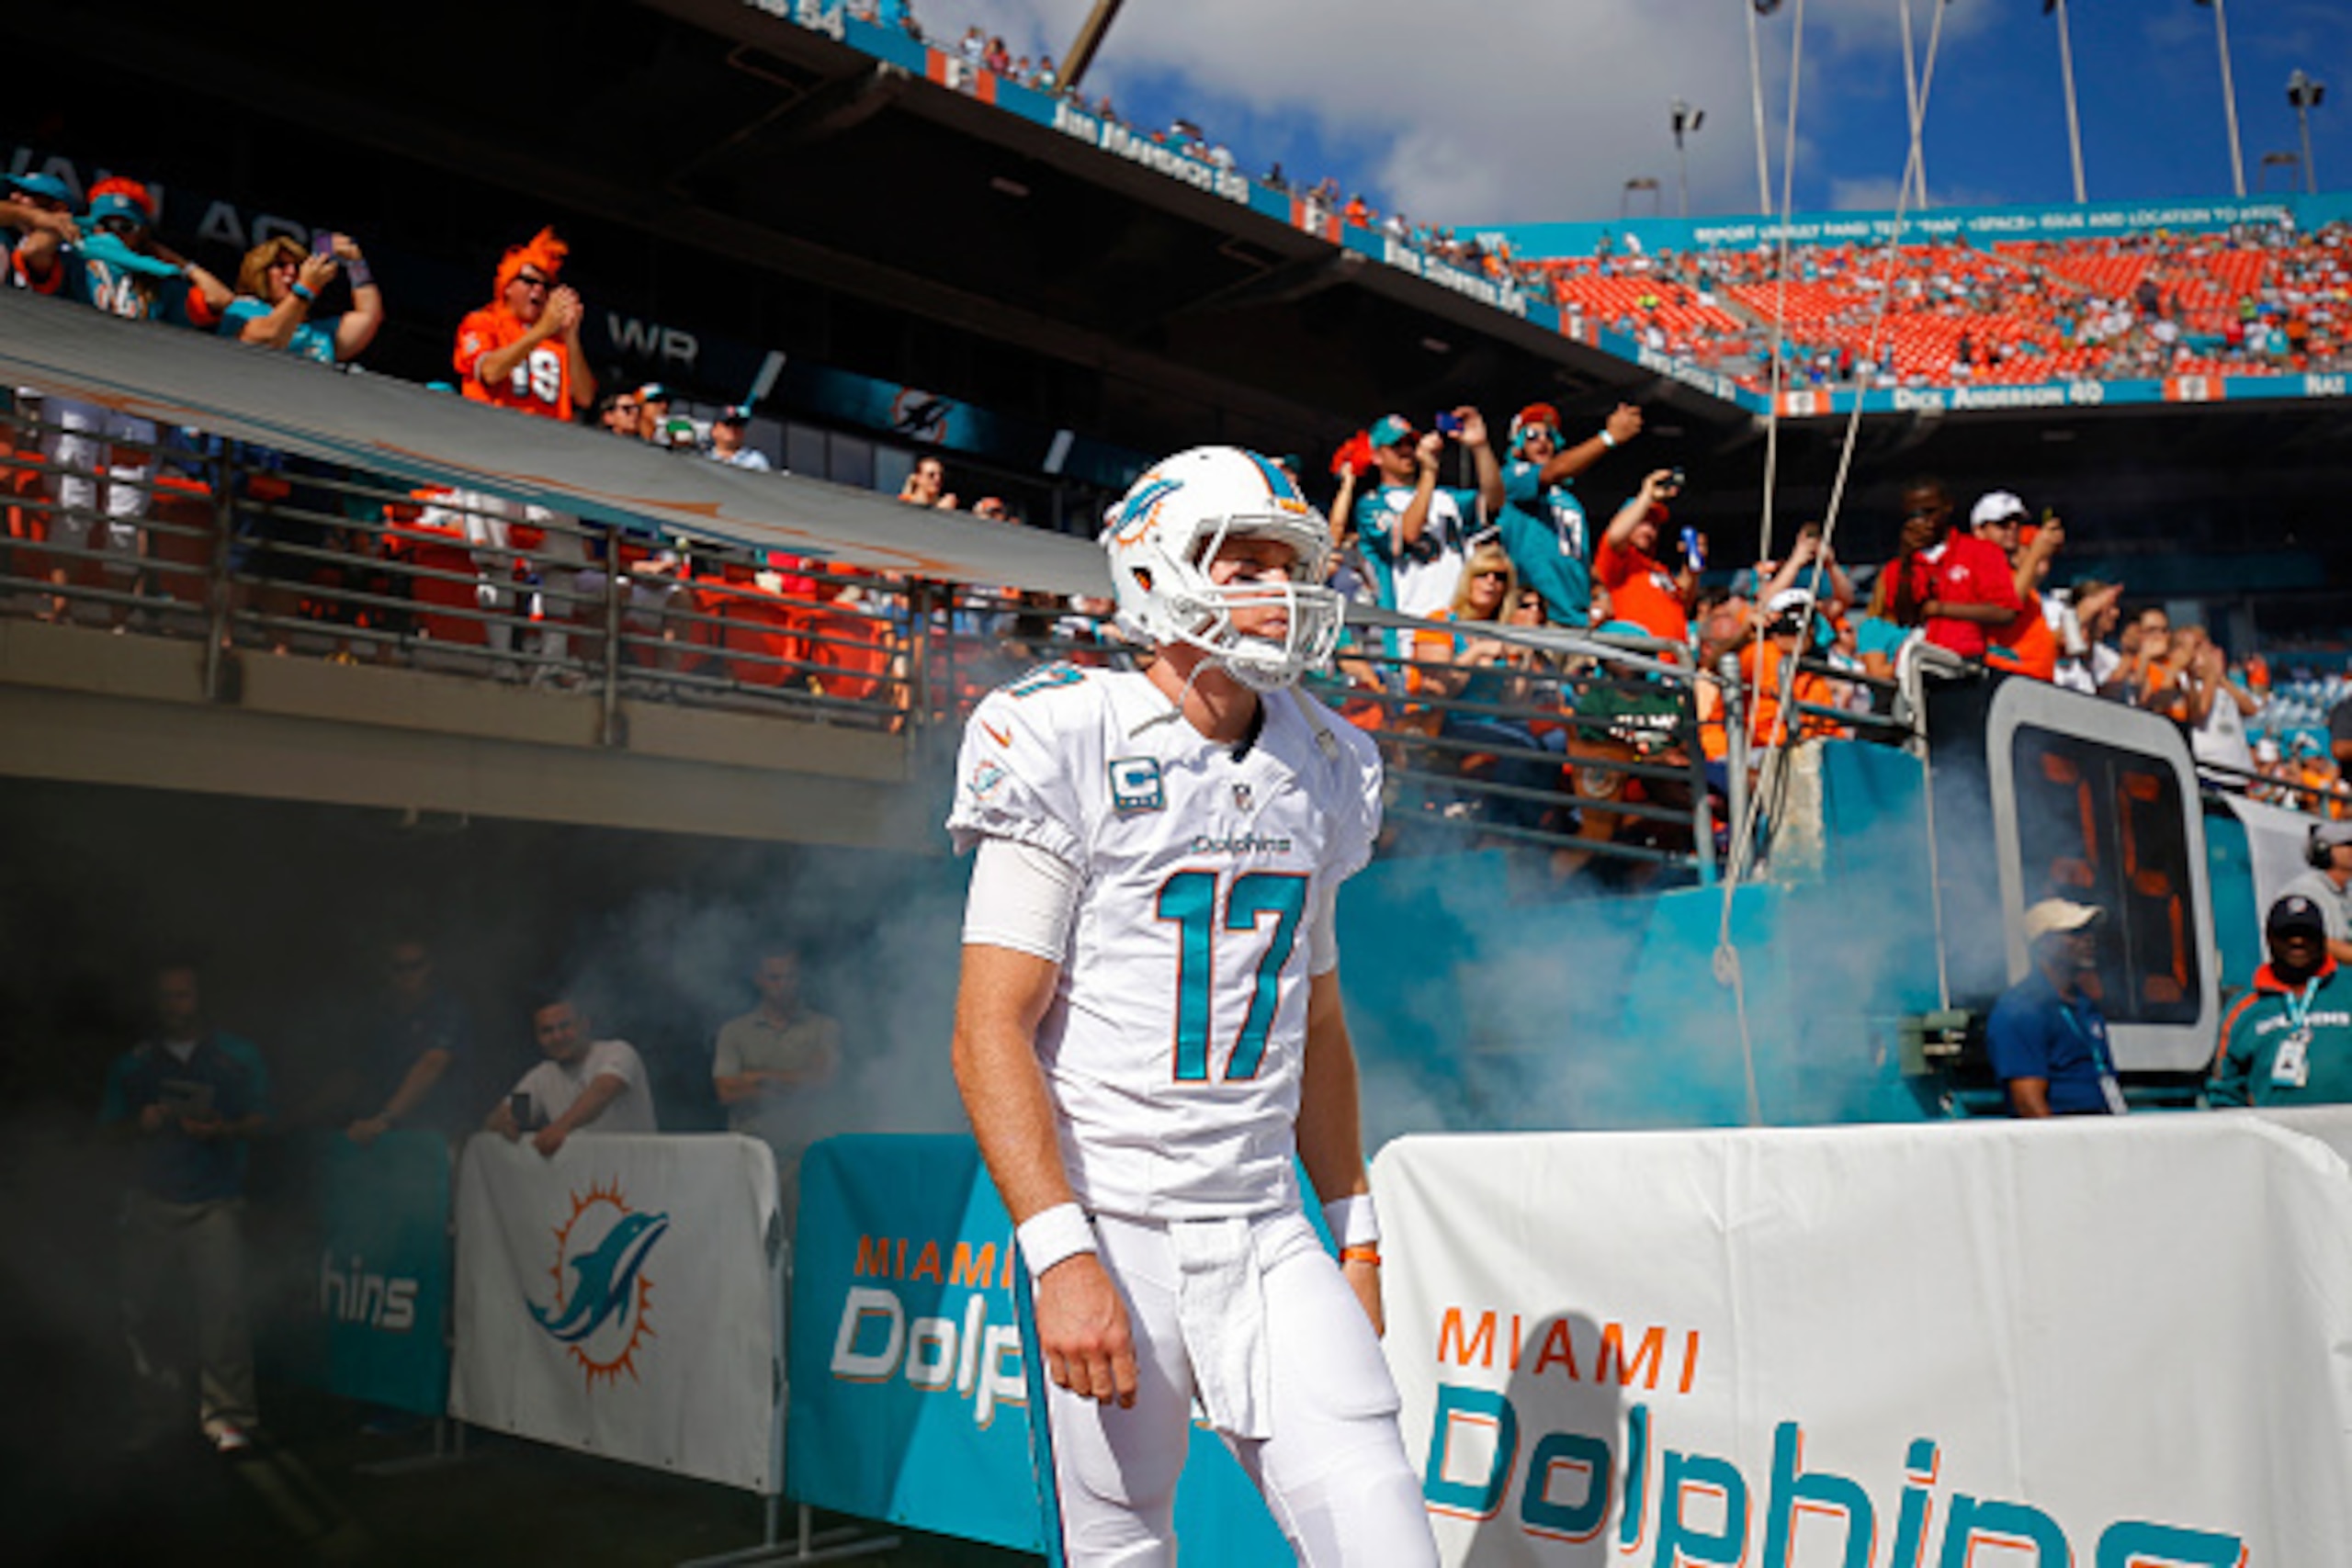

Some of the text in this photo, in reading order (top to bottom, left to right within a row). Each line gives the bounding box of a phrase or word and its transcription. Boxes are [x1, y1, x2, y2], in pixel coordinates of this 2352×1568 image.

[1192, 831, 1292, 856] Dolphins
[1156, 866, 1311, 1084] 17
[854, 1234, 1015, 1290] MIAMI
[1438, 1307, 1700, 1393] MIAMI
